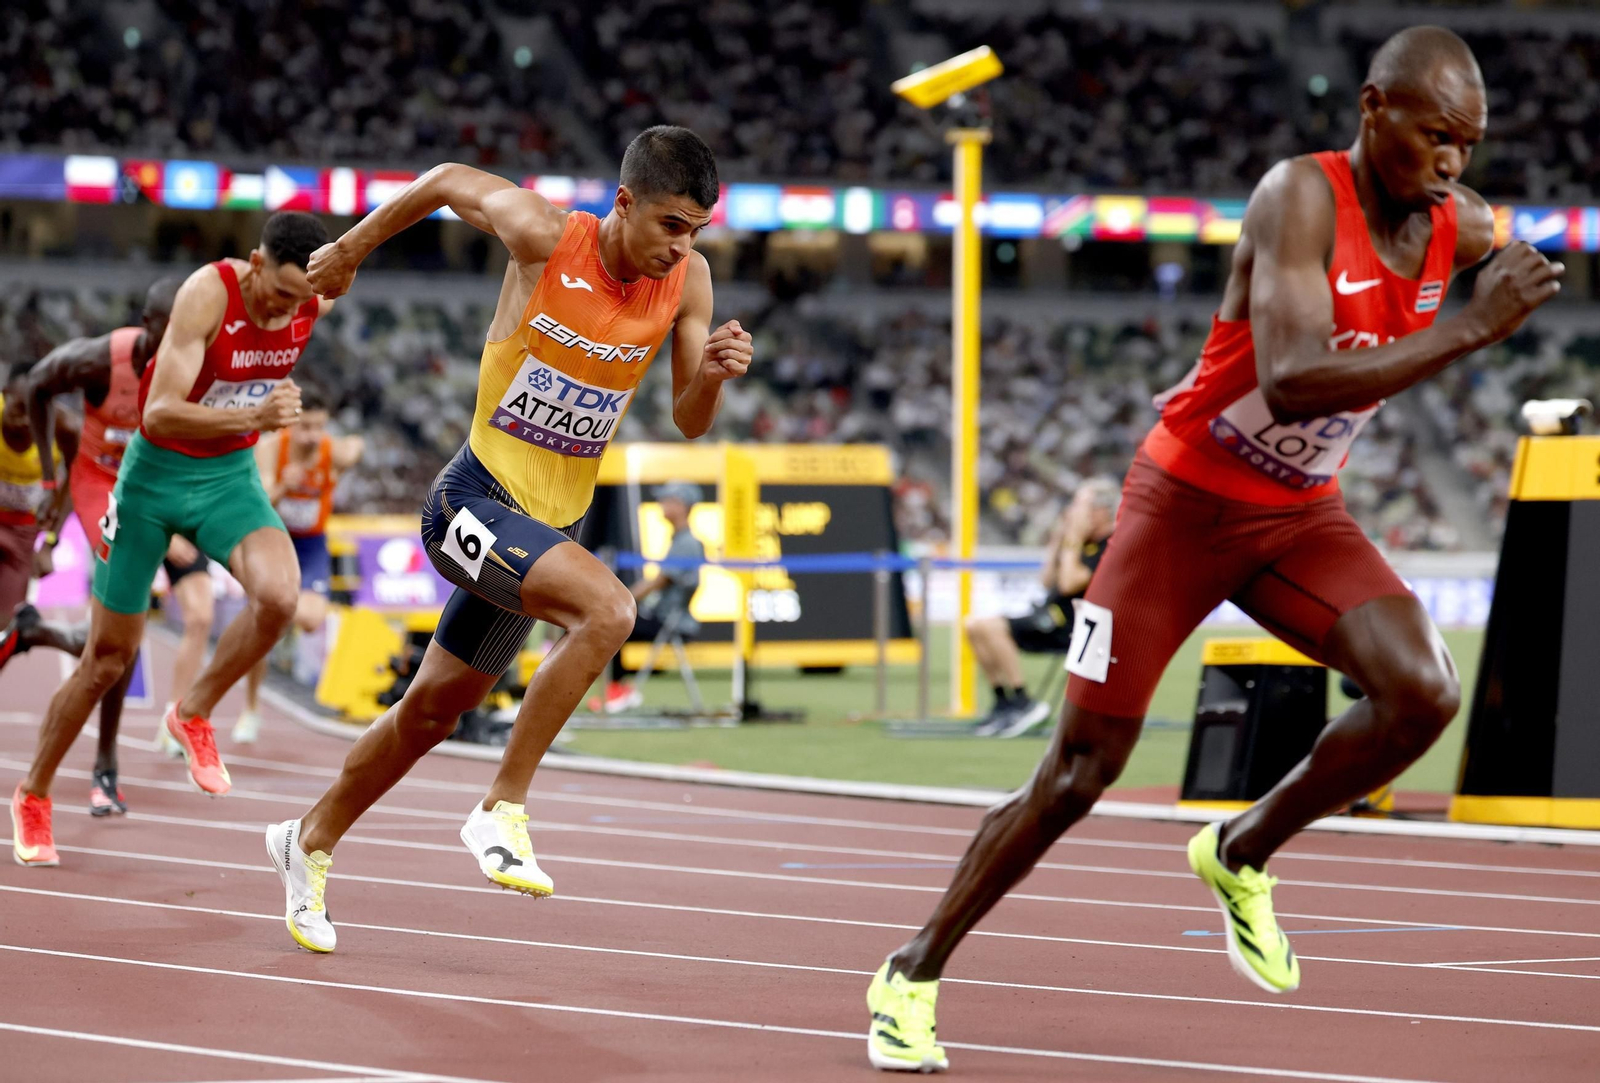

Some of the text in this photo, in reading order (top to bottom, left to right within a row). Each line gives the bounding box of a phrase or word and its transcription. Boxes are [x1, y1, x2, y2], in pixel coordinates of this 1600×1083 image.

[231, 347, 300, 369] MOROCCO
[528, 312, 652, 364] ESPAÑA
[507, 391, 615, 439] ATTAOUI
[556, 375, 628, 413] TDK
[1253, 421, 1330, 466] LOT
[455, 525, 482, 561] 6
[1078, 617, 1097, 663] 7
[285, 829, 294, 871] RUNNING
